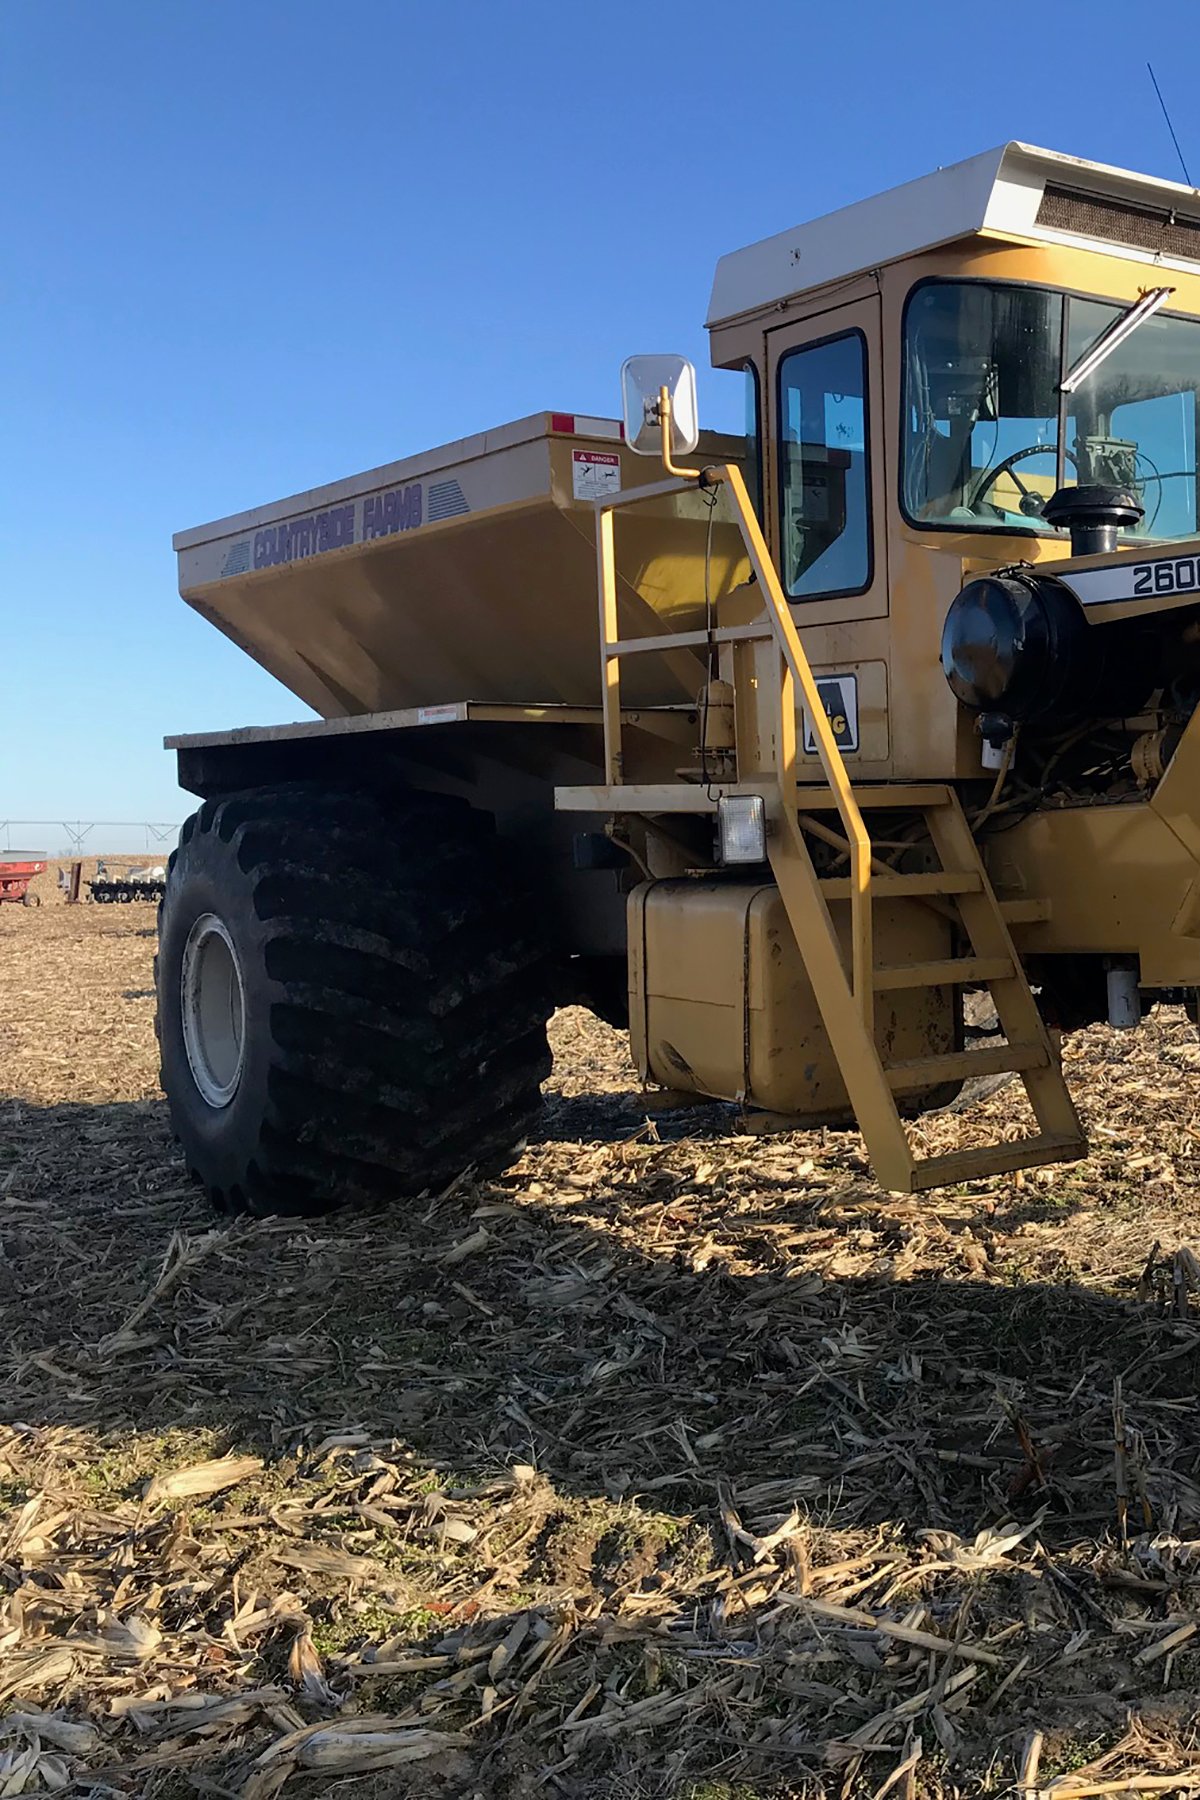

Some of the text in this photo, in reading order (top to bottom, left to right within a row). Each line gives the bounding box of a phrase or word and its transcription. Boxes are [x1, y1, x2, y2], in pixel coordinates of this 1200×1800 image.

[591, 455, 615, 464] DANGER
[254, 483, 422, 569] COUNTRYSIDE FARMS
